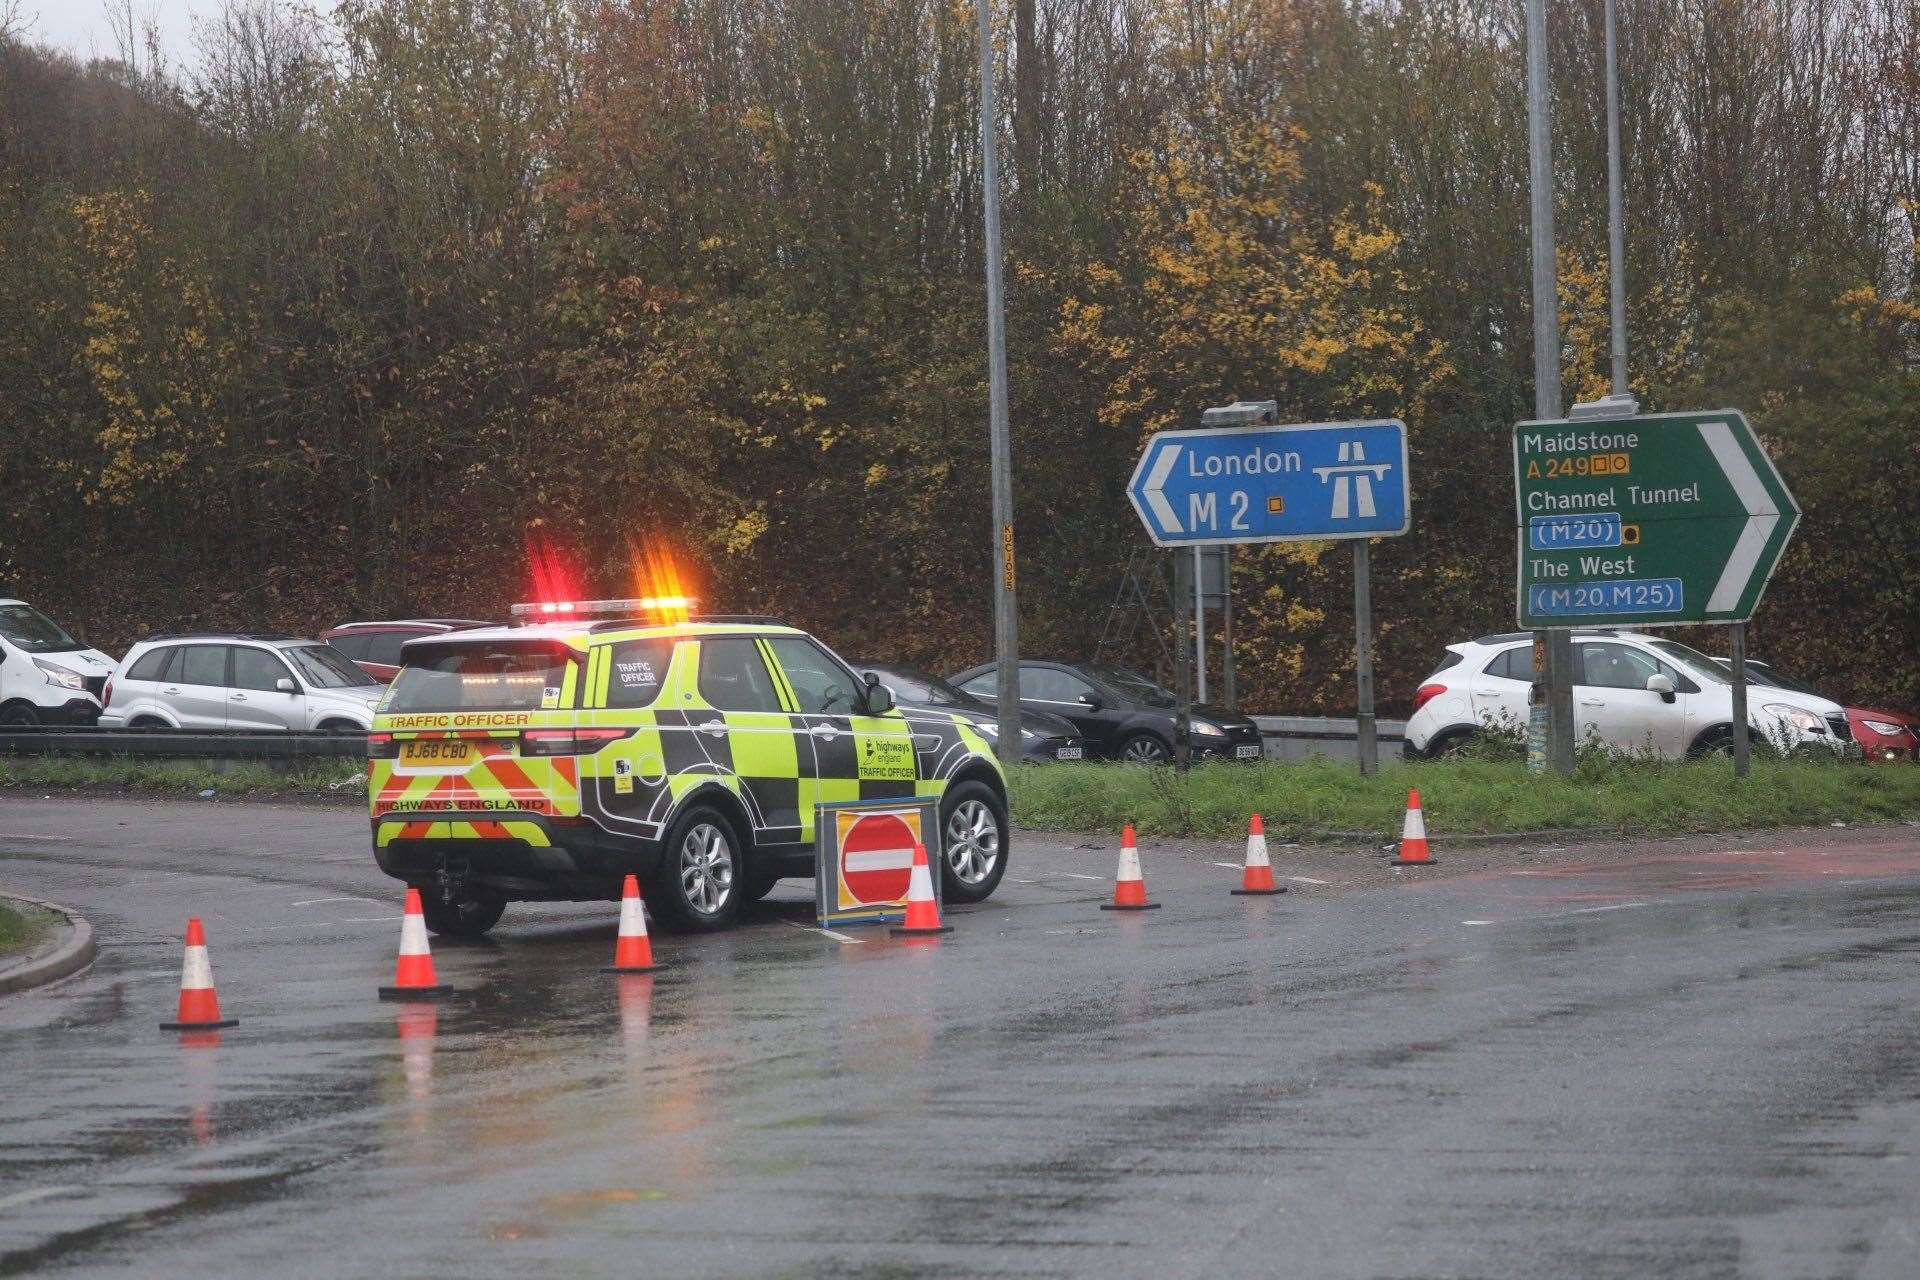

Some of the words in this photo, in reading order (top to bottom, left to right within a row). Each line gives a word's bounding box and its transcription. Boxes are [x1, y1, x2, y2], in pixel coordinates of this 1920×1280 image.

[1523, 432, 1639, 453] Maidstone
[1188, 447, 1302, 477] London
[1528, 488, 1617, 510] Channel
[1627, 482, 1700, 505] Tunnel
[1538, 521, 1613, 544] (M20)
[1529, 559, 1569, 577] The
[1580, 555, 1635, 575] West
[616, 662, 651, 672] TRAFFIC
[620, 672, 656, 682] OFFICER
[390, 715, 449, 727] TRAFFIC
[453, 714, 529, 726] OFFICER
[876, 741, 910, 754] highways
[860, 767, 886, 777] TRAFFIC
[887, 767, 915, 777] OFFICER
[377, 800, 454, 811] HIGHWAYS
[458, 800, 545, 810] ENGLAND
